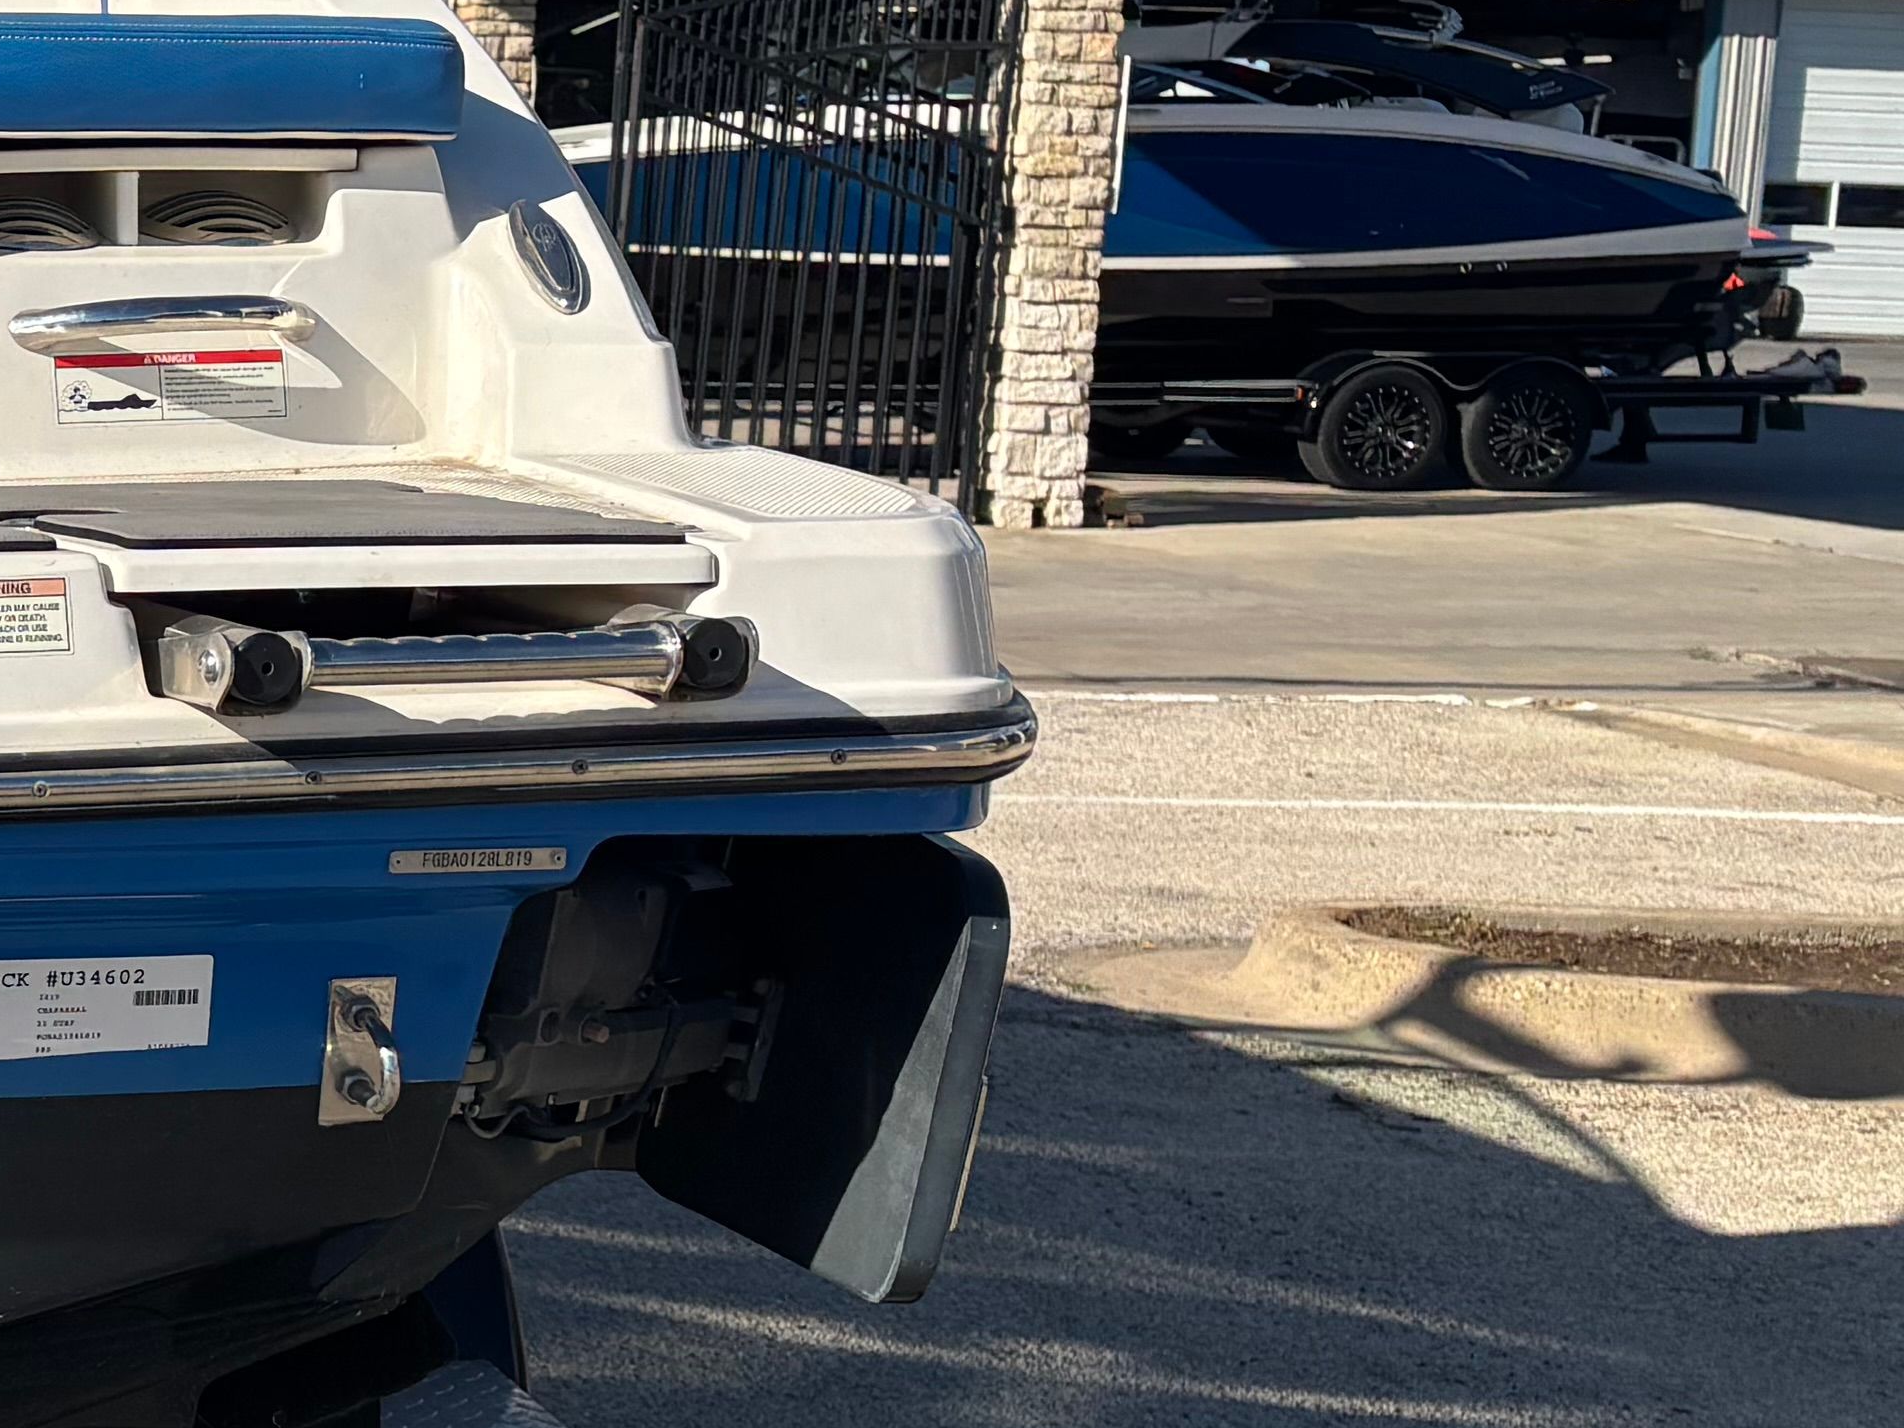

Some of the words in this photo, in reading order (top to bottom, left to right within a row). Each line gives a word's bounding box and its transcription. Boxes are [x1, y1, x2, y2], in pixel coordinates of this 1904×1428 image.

[153, 353, 196, 364] DANGER
[14, 604, 30, 612] MAY
[33, 603, 60, 611] CAUSE
[18, 624, 30, 632] OR
[32, 623, 48, 632] USE
[47, 969, 145, 987] #U34602
